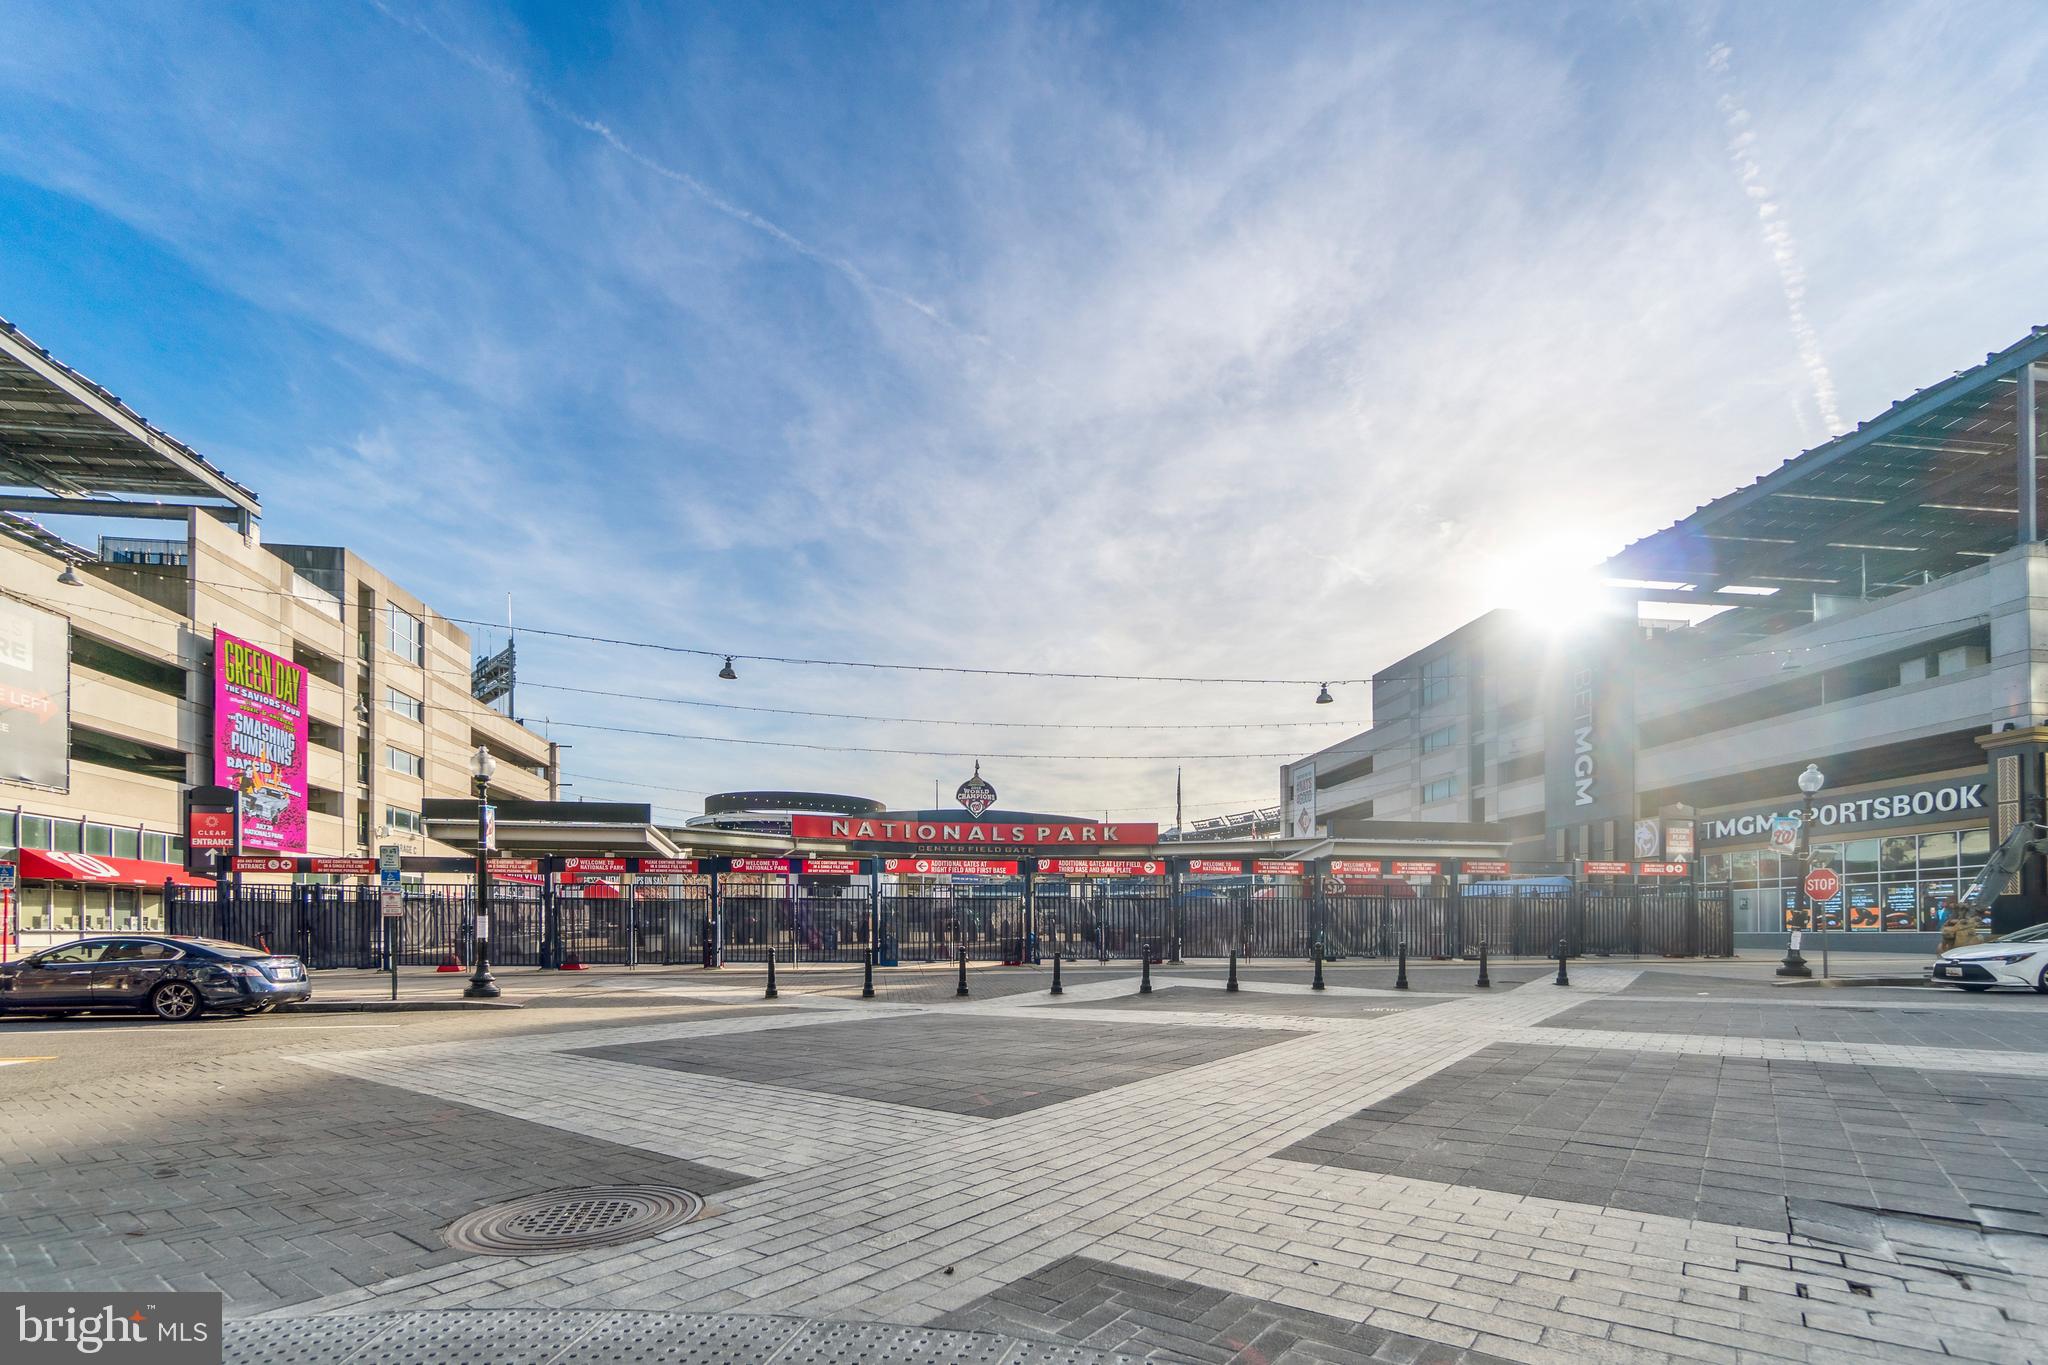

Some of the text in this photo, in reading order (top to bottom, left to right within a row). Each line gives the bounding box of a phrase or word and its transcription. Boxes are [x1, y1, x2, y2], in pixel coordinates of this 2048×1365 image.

[224, 640, 300, 706] GREEN DAY
[10, 690, 50, 712] LEFT
[224, 684, 240, 694] THE
[241, 689, 280, 709] SAVIORS
[282, 704, 300, 718] TOUR
[236, 713, 296, 751] SMASHING
[1574, 667, 1592, 806] BETMGM
[226, 756, 272, 774] RANCID
[231, 732, 292, 767] PUMPKINS
[832, 820, 1118, 841] NATIONALS PARK
[1807, 878, 1835, 891] STOP
